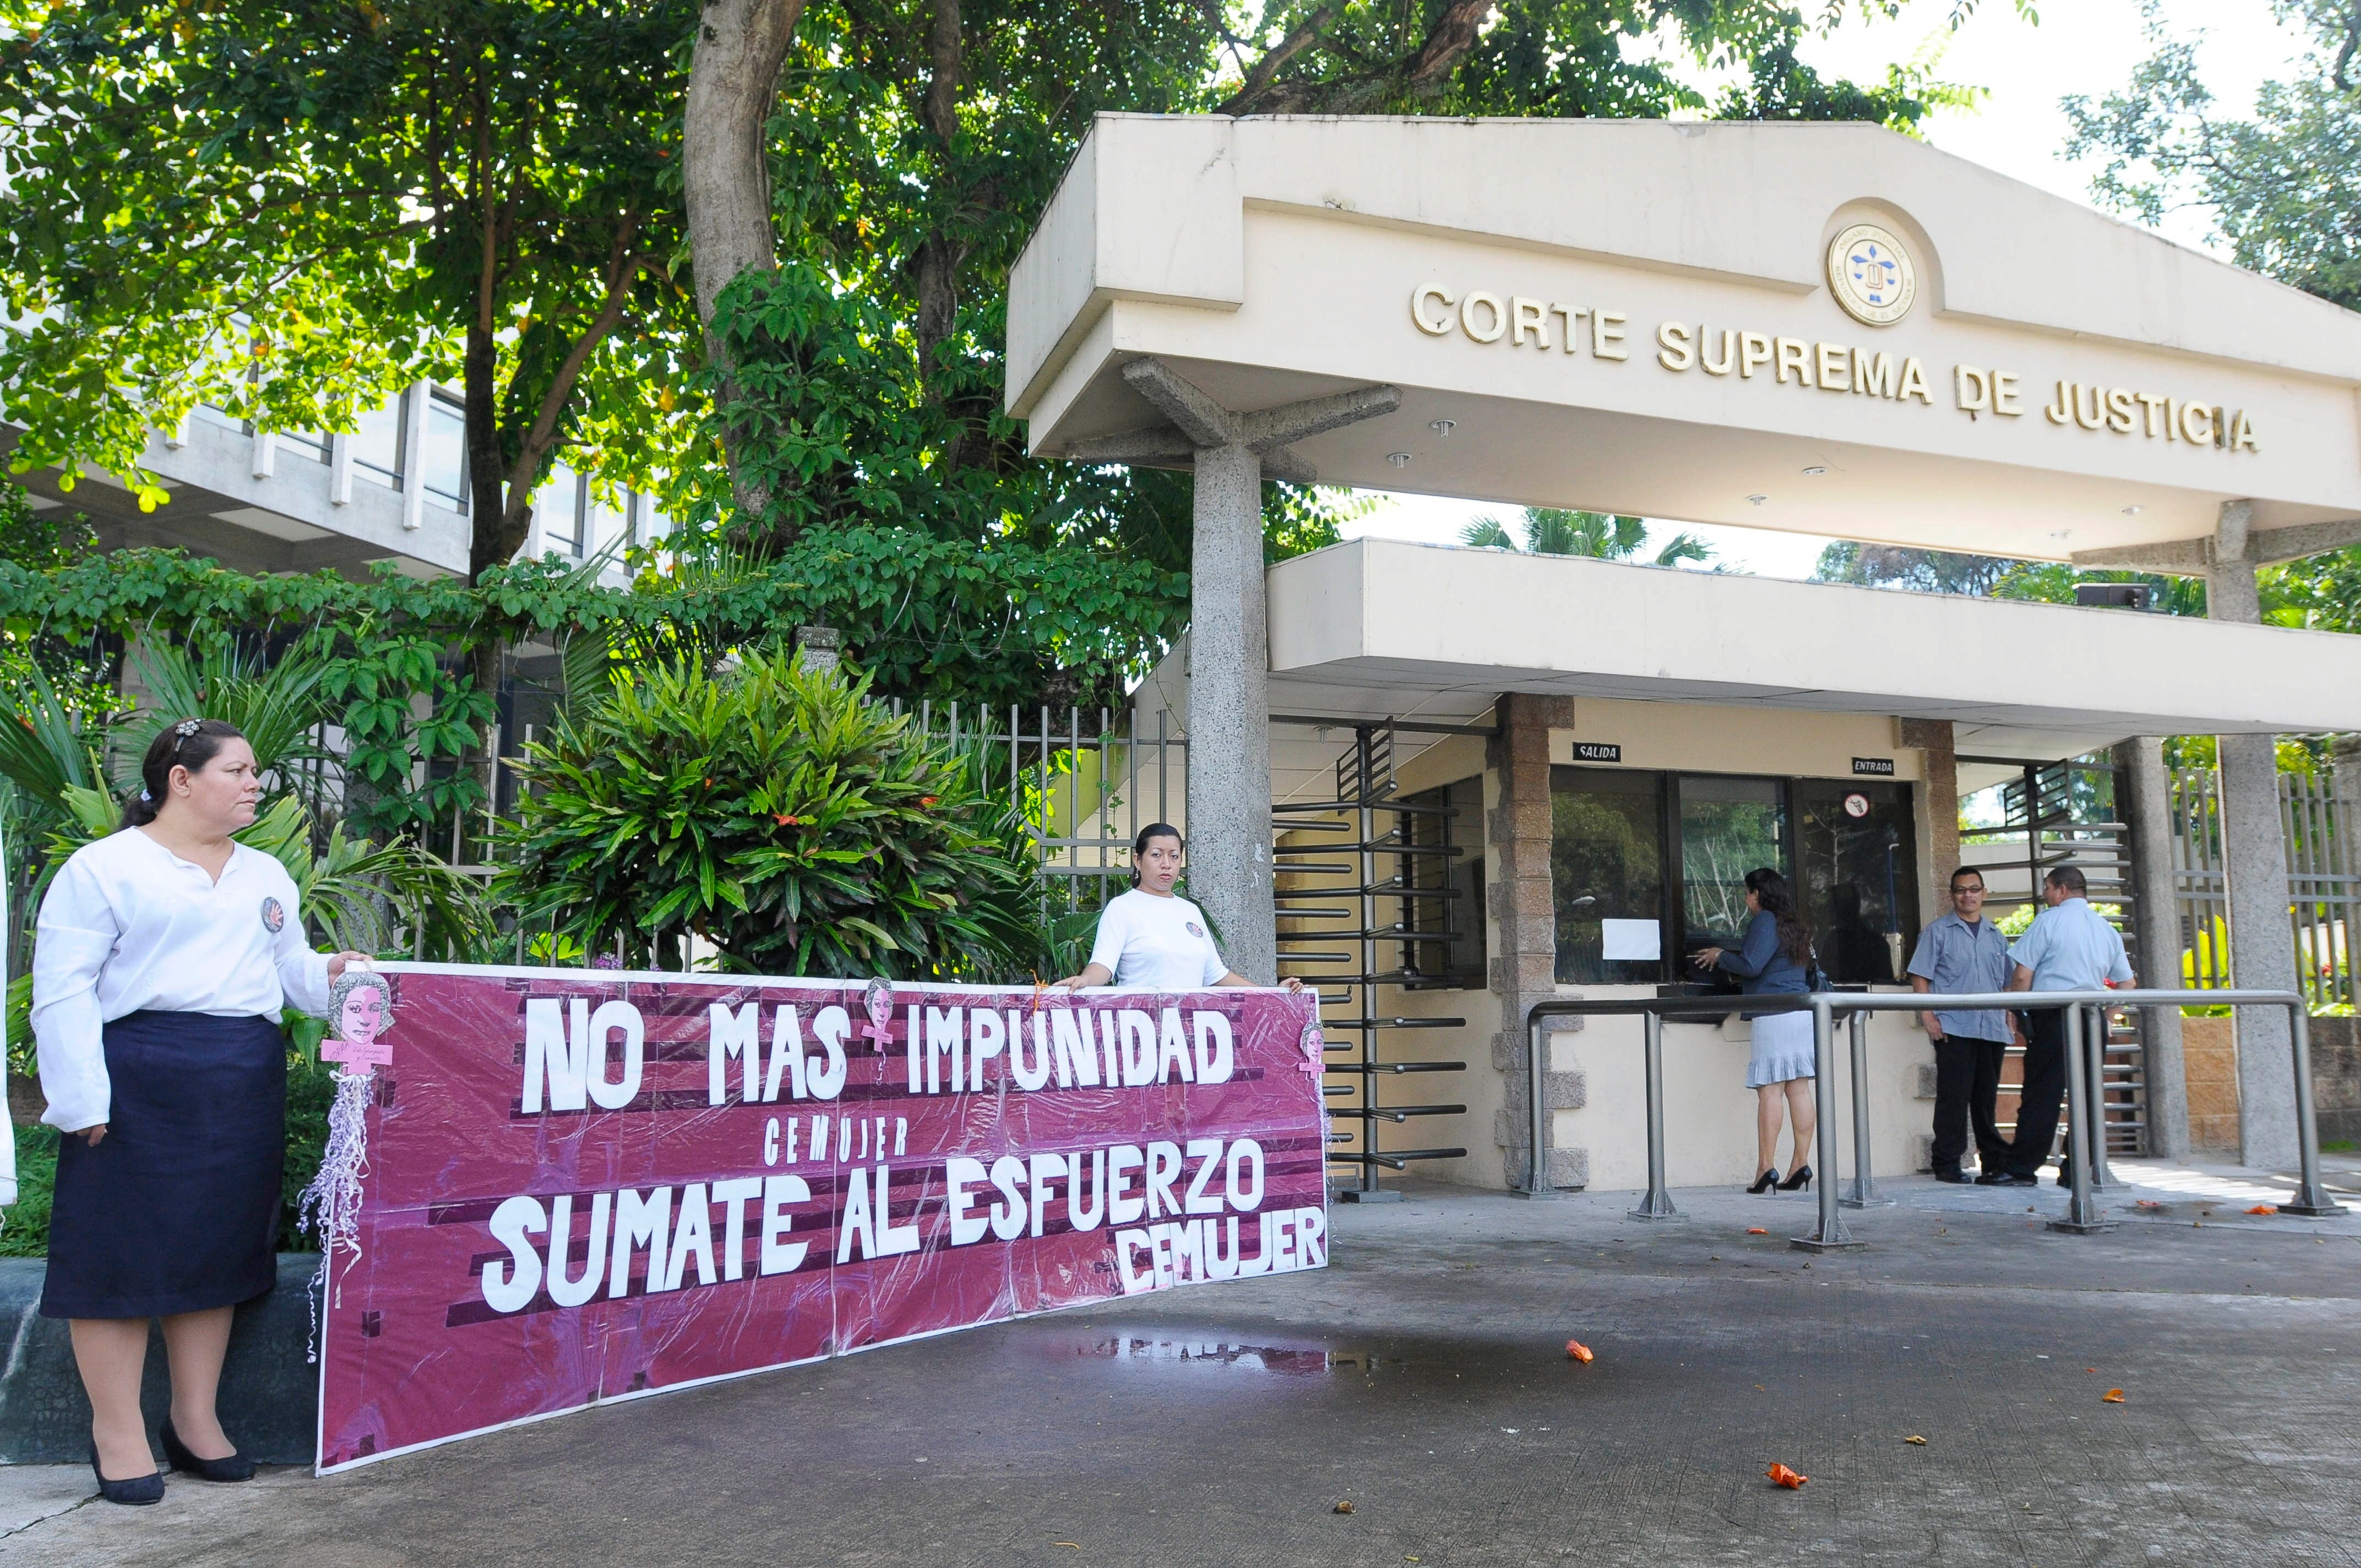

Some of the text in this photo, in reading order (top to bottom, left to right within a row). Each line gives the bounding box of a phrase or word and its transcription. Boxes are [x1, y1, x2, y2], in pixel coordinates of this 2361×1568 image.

[1410, 282, 2259, 452] CORTE SUPREMA DE JUSTICIA
[1580, 745, 1616, 758] SALIDA
[1854, 761, 1892, 772] ENTRADA
[521, 998, 1235, 1114] NO MAS IMPUNIDAD
[763, 1115, 907, 1167] CEMUJER
[481, 1137, 1265, 1313] SUMATE AL ESFUERZO
[1115, 1206, 1326, 1295] CEMUJER
